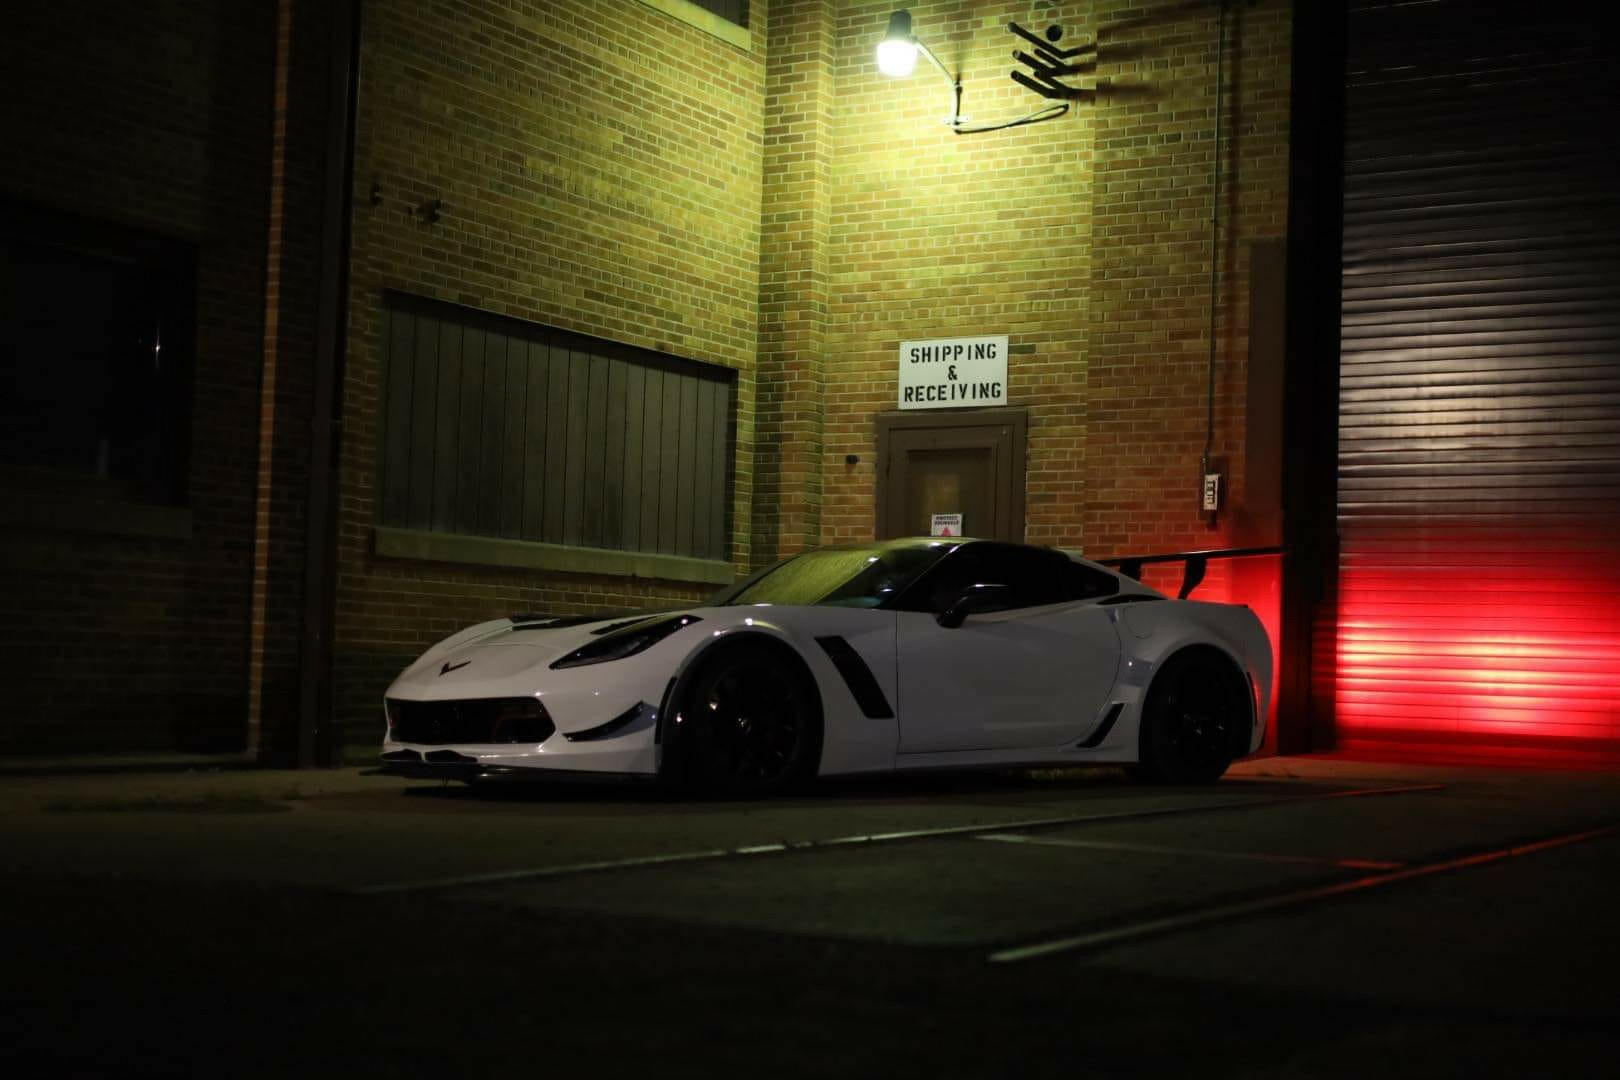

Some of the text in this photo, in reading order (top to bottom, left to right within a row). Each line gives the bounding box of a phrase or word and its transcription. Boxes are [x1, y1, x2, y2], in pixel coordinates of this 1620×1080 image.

[911, 344, 996, 363] SHIPPING
[948, 365, 957, 380] &
[904, 382, 1001, 402] RECEIVING
